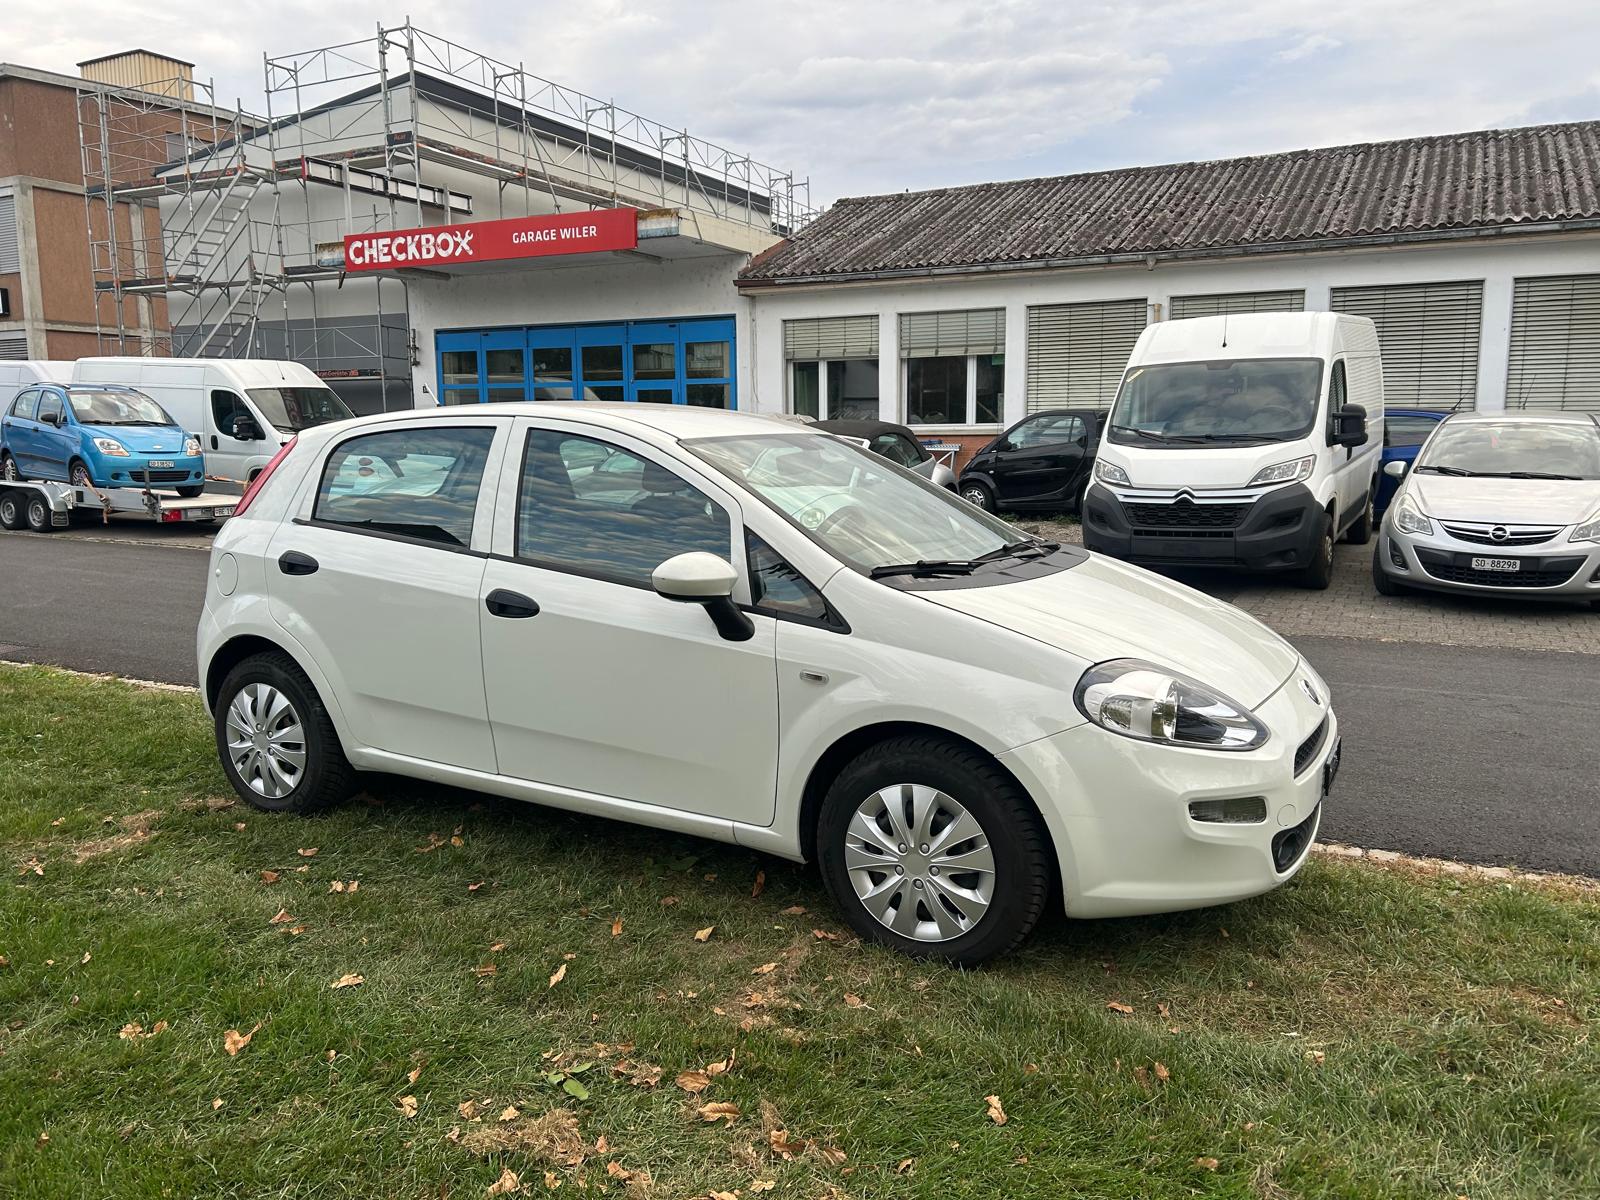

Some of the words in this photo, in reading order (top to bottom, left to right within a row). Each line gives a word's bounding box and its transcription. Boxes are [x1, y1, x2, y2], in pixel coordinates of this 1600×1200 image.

[348, 229, 474, 265] CHECKBOX
[512, 228, 557, 244] GARAGE
[559, 225, 597, 240] WILER
